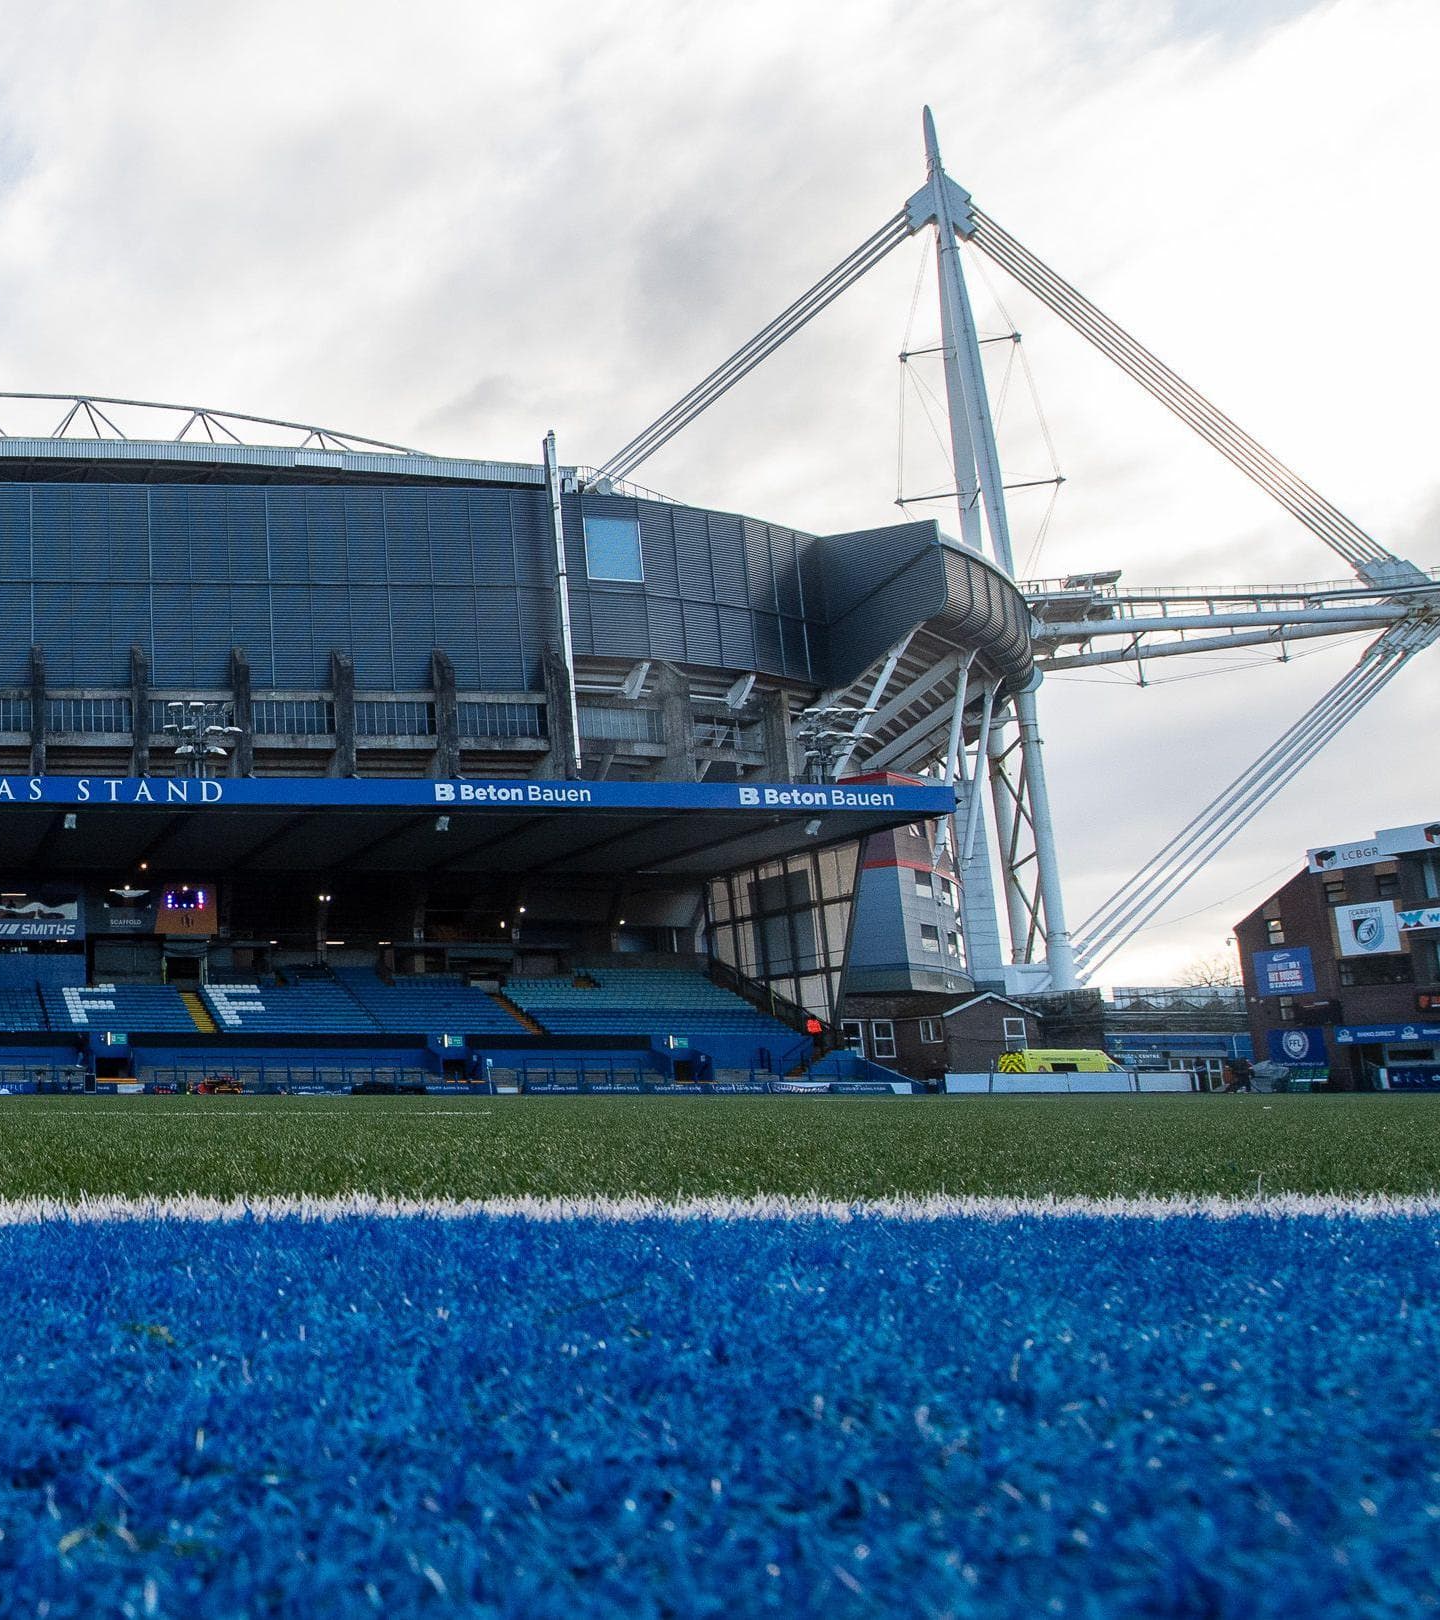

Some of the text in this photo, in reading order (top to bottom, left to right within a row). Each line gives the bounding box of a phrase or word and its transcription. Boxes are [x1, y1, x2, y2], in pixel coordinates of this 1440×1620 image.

[77, 779, 224, 803] STAND
[460, 784, 524, 802] Beton
[528, 785, 591, 802] Bauen
[764, 788, 827, 806] Beton
[832, 789, 895, 806] Bauen
[1350, 907, 1380, 916] CARDIFF
[20, 923, 76, 935] SMITHS
[1269, 980, 1303, 989] STATION
[1289, 1039, 1301, 1047] FFL
